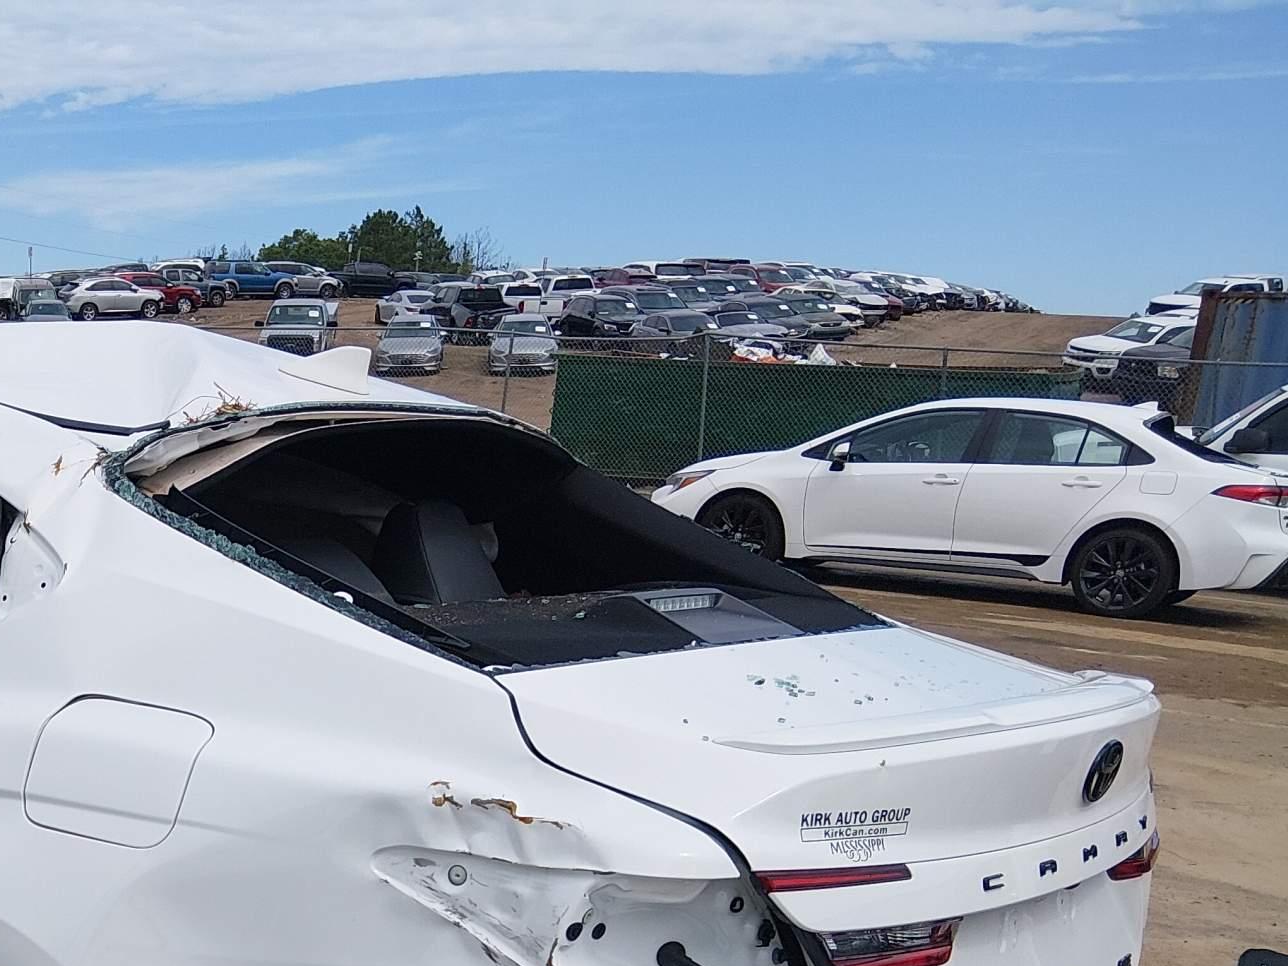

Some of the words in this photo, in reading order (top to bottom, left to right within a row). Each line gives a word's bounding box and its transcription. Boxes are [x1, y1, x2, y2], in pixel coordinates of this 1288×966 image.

[801, 812, 833, 828] KIRK
[835, 810, 868, 826] AUTO
[871, 807, 911, 823] GROUP
[824, 827, 888, 839] KirkCan.com
[830, 838, 886, 862] MISSISSIPPI
[982, 815, 1148, 892] CAMRY
